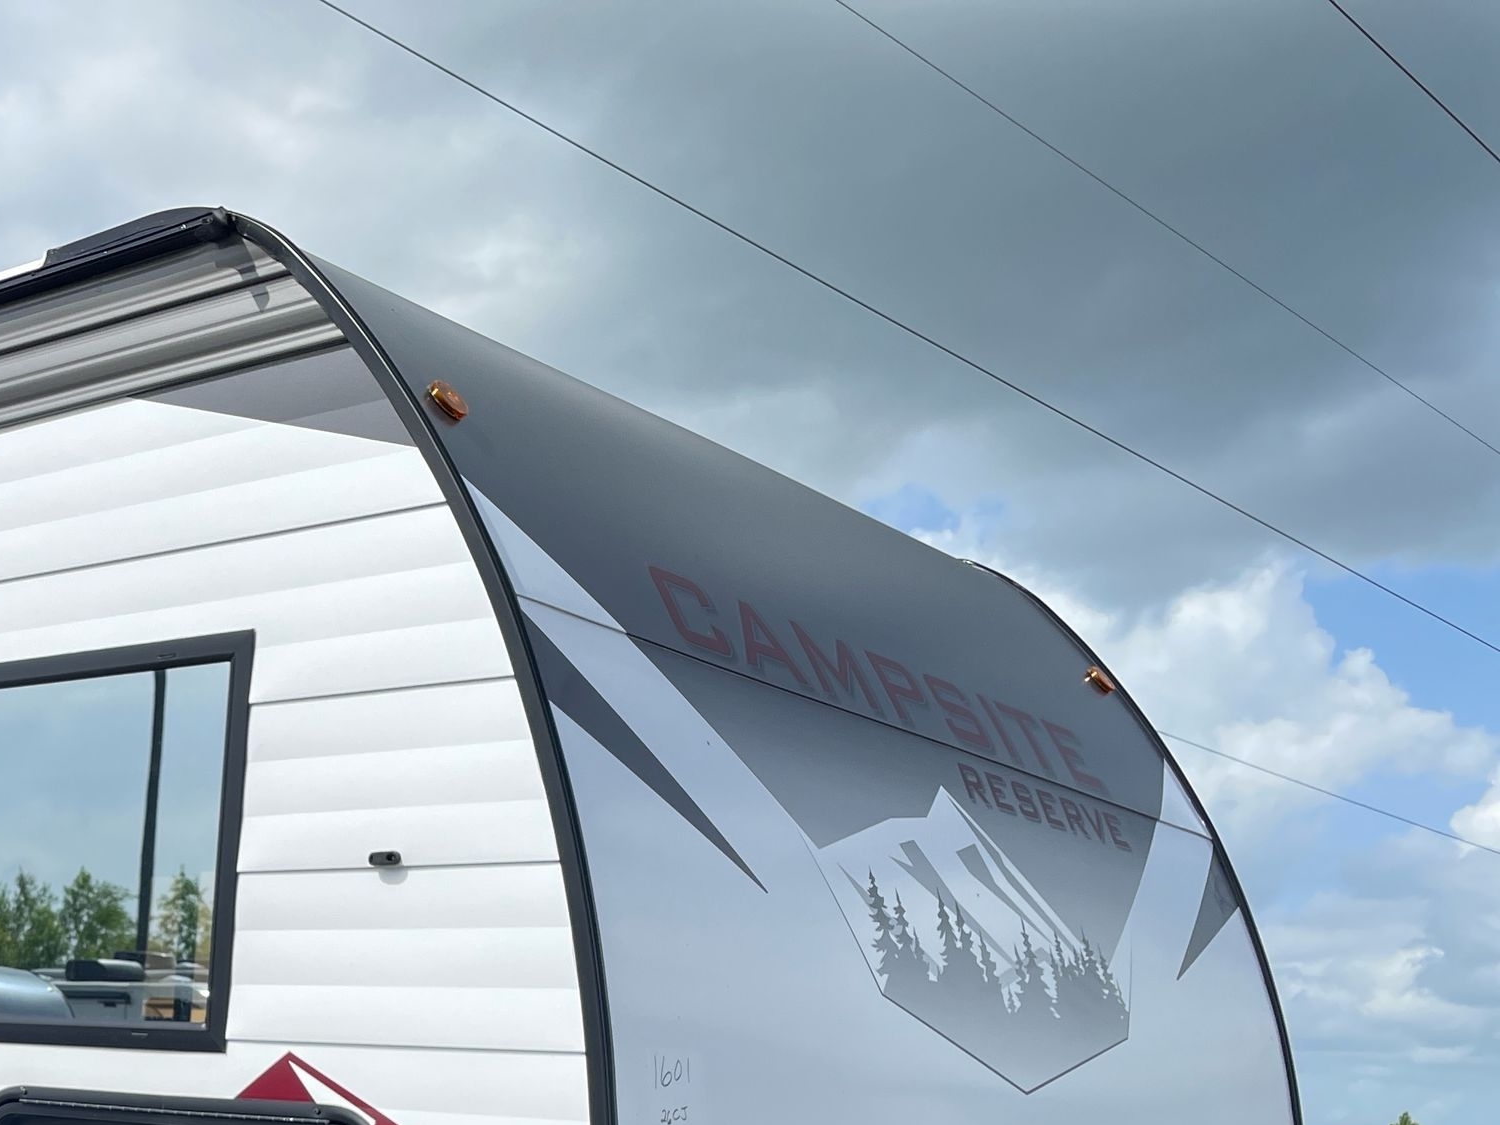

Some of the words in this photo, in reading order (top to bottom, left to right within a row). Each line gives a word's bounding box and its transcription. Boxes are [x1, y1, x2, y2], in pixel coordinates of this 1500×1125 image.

[647, 564, 1108, 798] CAMPSITE
[957, 762, 1133, 852] RESERVE
[654, 1055, 690, 1090] 1601
